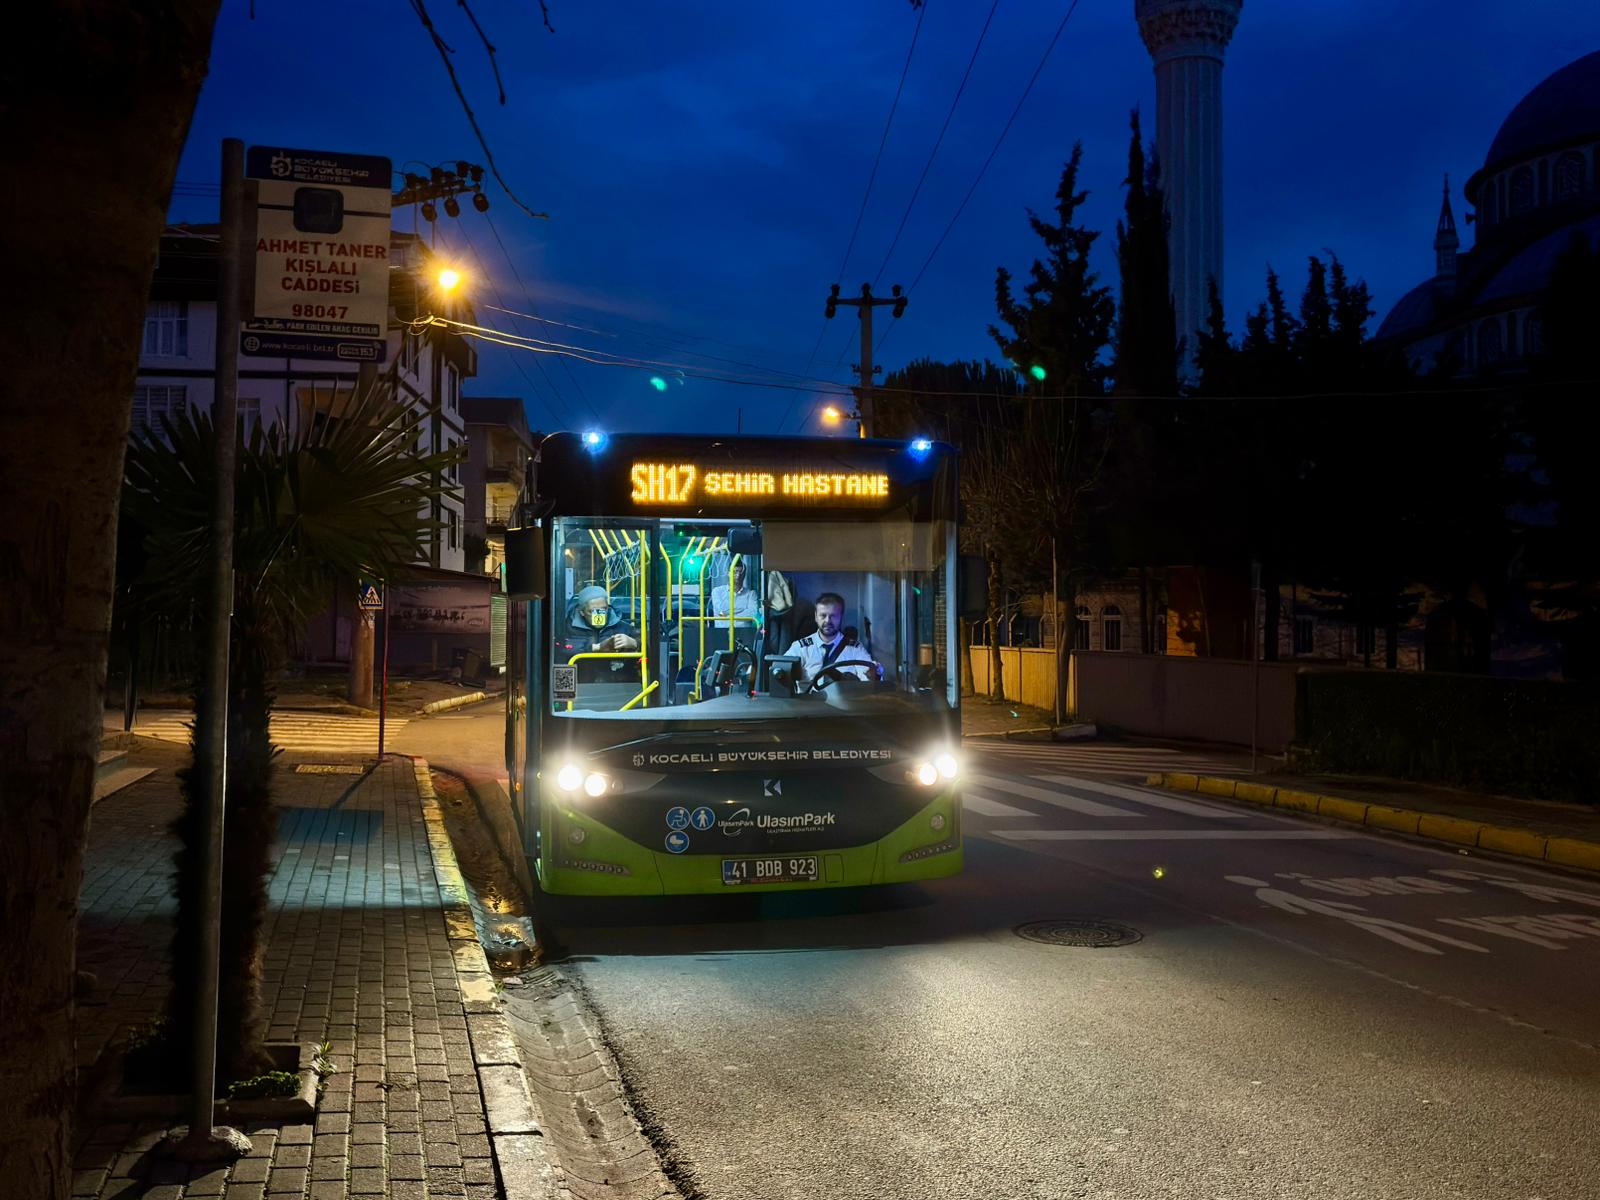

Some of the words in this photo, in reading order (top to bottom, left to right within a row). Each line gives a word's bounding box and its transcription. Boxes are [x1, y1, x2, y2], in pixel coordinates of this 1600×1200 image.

[256, 238, 322, 255] AHMET
[327, 242, 387, 259] TANER
[285, 258, 357, 277] KIŞLALI
[282, 277, 360, 294] CADDESİ
[291, 303, 349, 319] 98047
[631, 463, 697, 503] SH17
[782, 473, 890, 496] HASTANE
[649, 753, 713, 764] KOCAELİ
[718, 750, 809, 762] BÜYÜKŞEHİR
[812, 749, 892, 760] BELEDİYESİ
[732, 861, 747, 878] 41
[756, 860, 783, 877] BDB
[789, 858, 817, 876] 923
